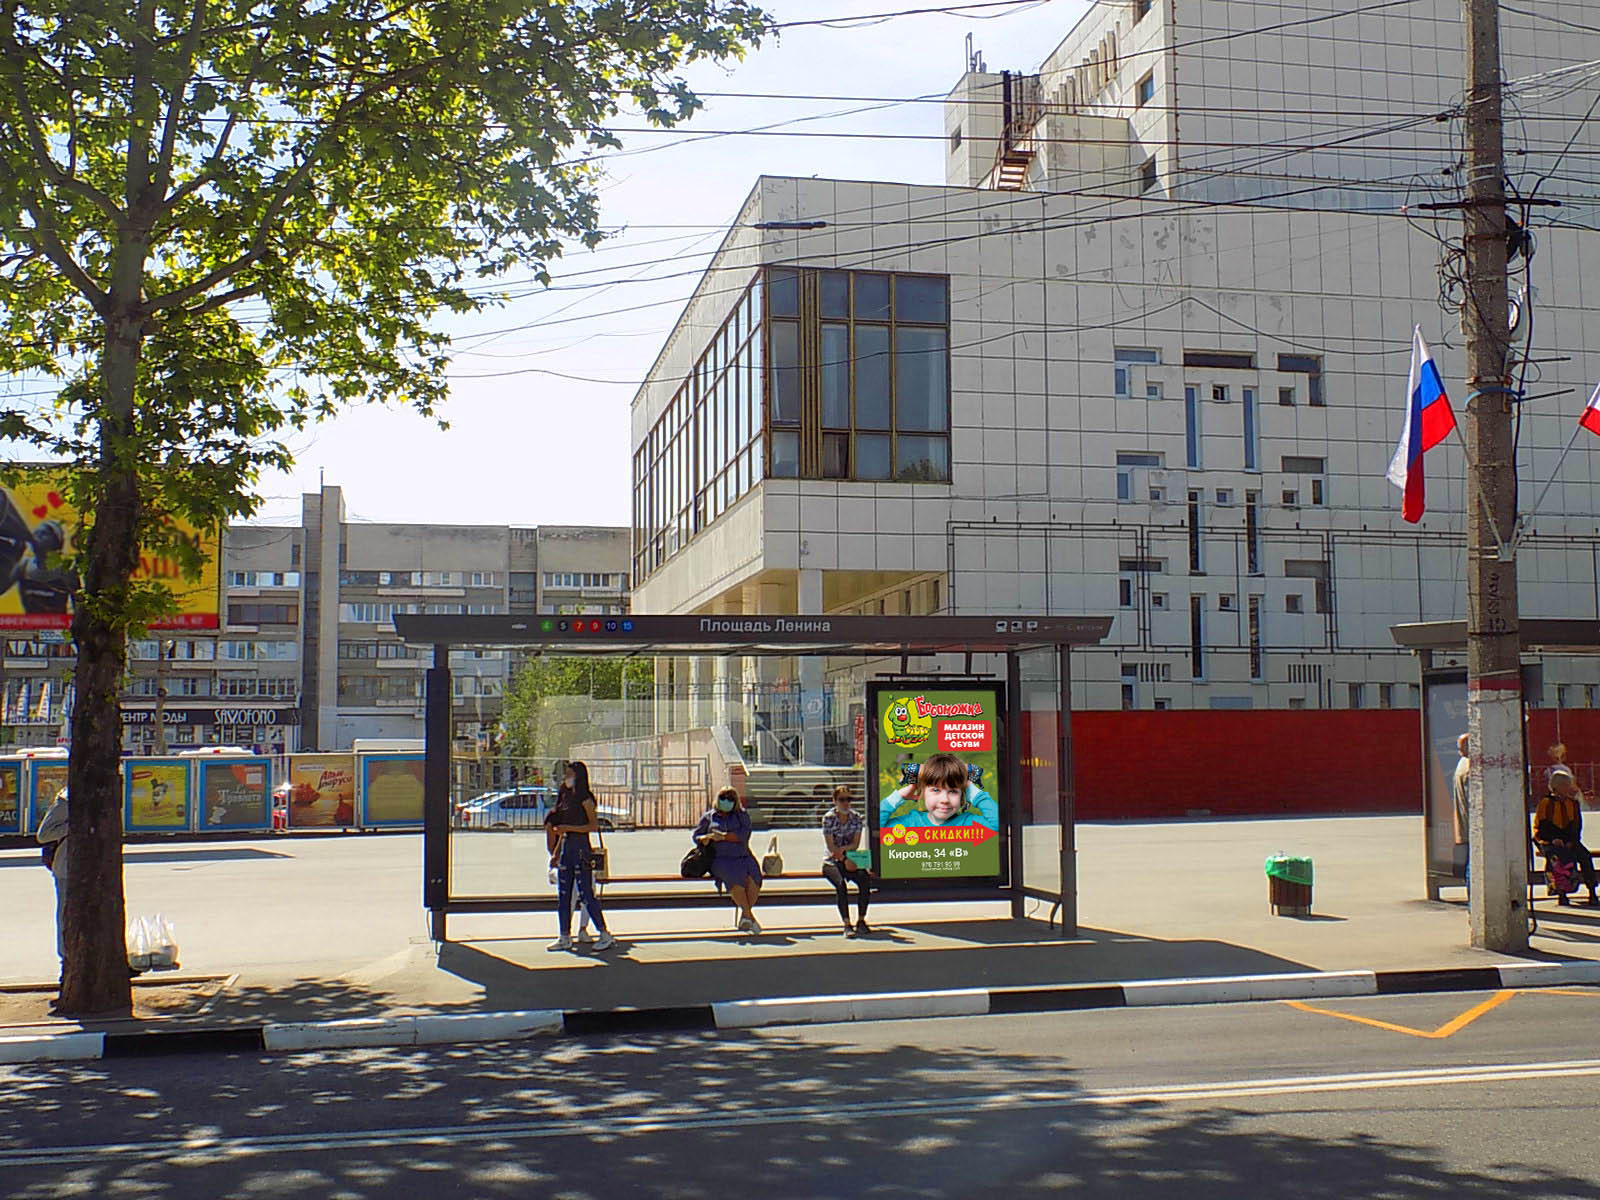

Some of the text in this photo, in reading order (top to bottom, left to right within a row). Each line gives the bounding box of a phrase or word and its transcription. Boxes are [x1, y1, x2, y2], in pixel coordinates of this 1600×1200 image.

[607, 621, 616, 631] 10
[700, 618, 831, 633] Площадь Ленина
[915, 696, 983, 718] Босоножка
[943, 723, 985, 731] МАГАЗИН
[944, 730, 985, 741] ДЕТСКОЙ
[924, 828, 984, 841] СКИДКИ!!!
[888, 849, 931, 860] Кирова,
[933, 848, 946, 858] 34
